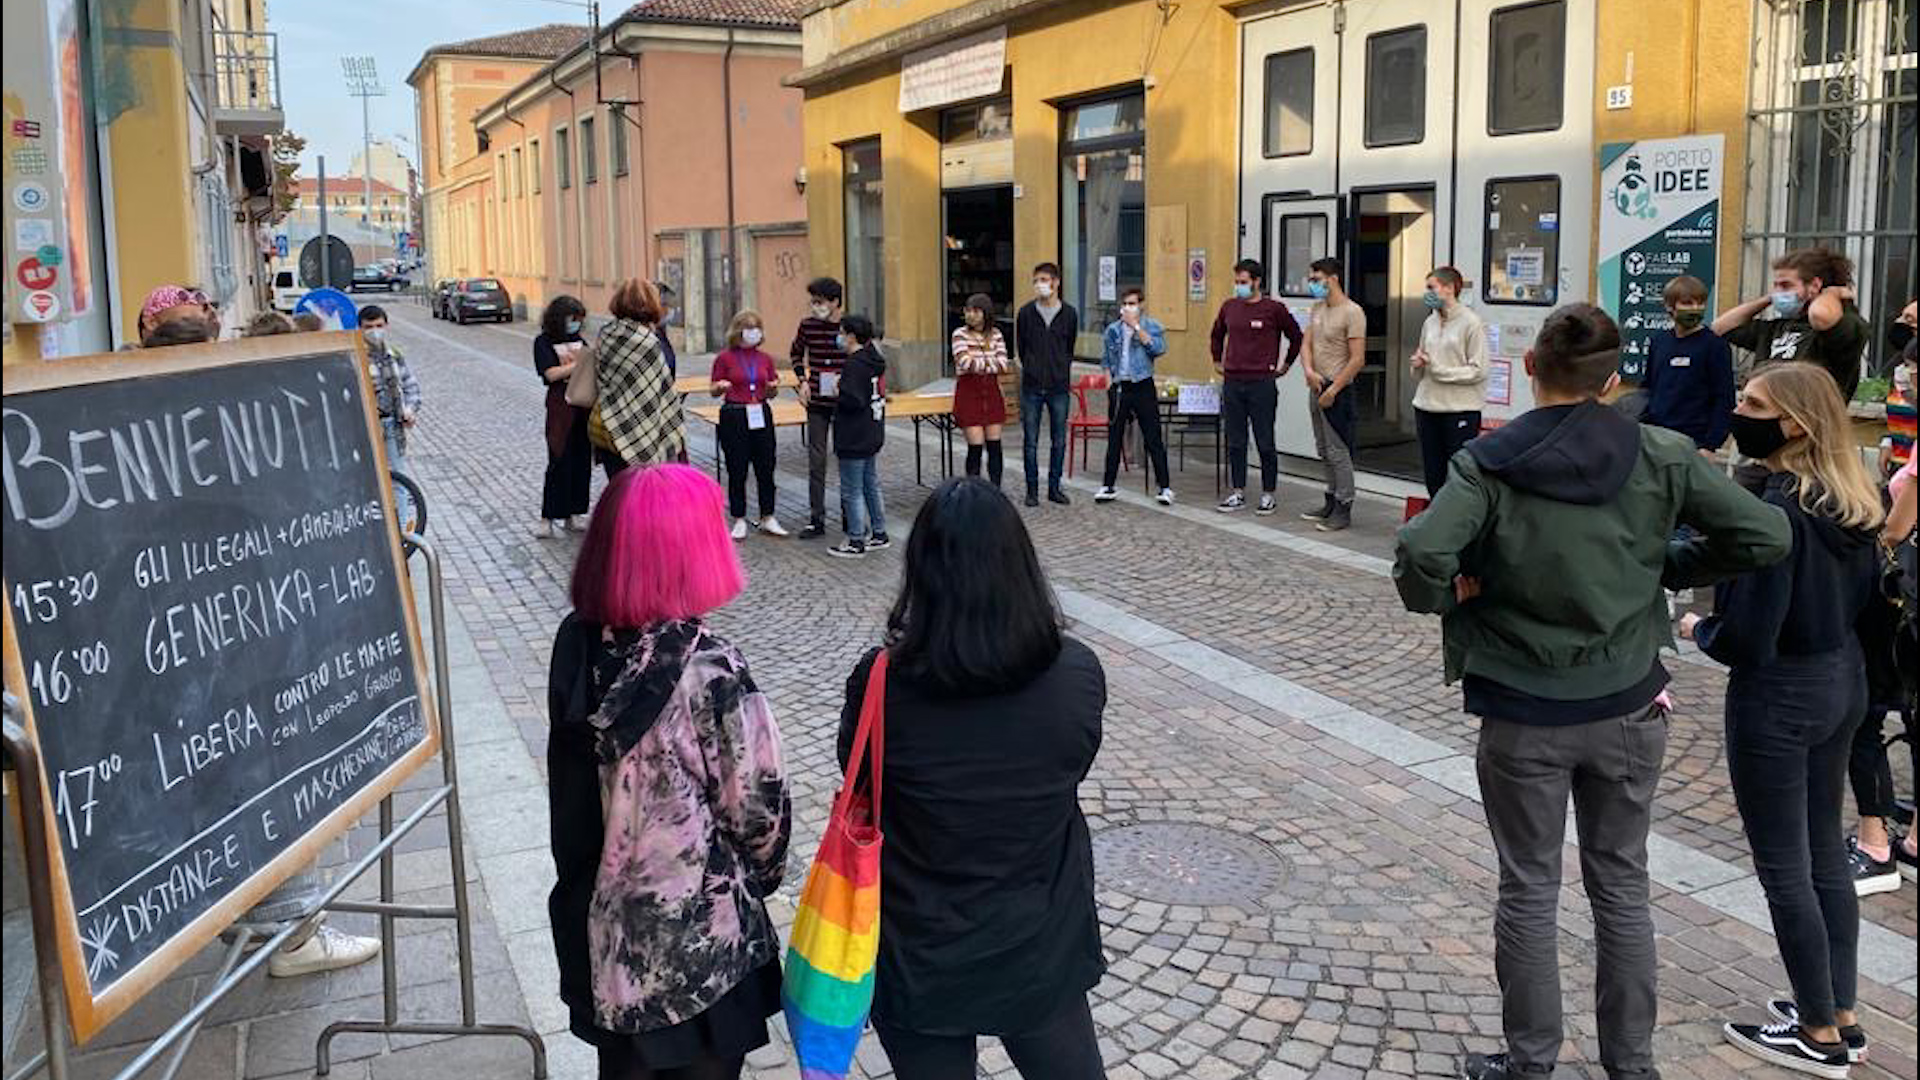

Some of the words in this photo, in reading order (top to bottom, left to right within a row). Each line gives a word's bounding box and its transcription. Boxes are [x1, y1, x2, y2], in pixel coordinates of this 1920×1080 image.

[1610, 90, 1626, 105] 95
[1654, 149, 1712, 167] PORTO
[1654, 169, 1710, 193] IDEE
[1646, 252, 1691, 264] FABLAB
[134, 545, 171, 589] GLI
[181, 524, 273, 581] ILLEGALI
[274, 661, 330, 714] CONTRO
[335, 651, 356, 680] LE
[357, 631, 402, 670] MAFIE
[271, 719, 299, 746] CON
[123, 833, 241, 944] DISTANZE
[262, 810, 280, 842] E
